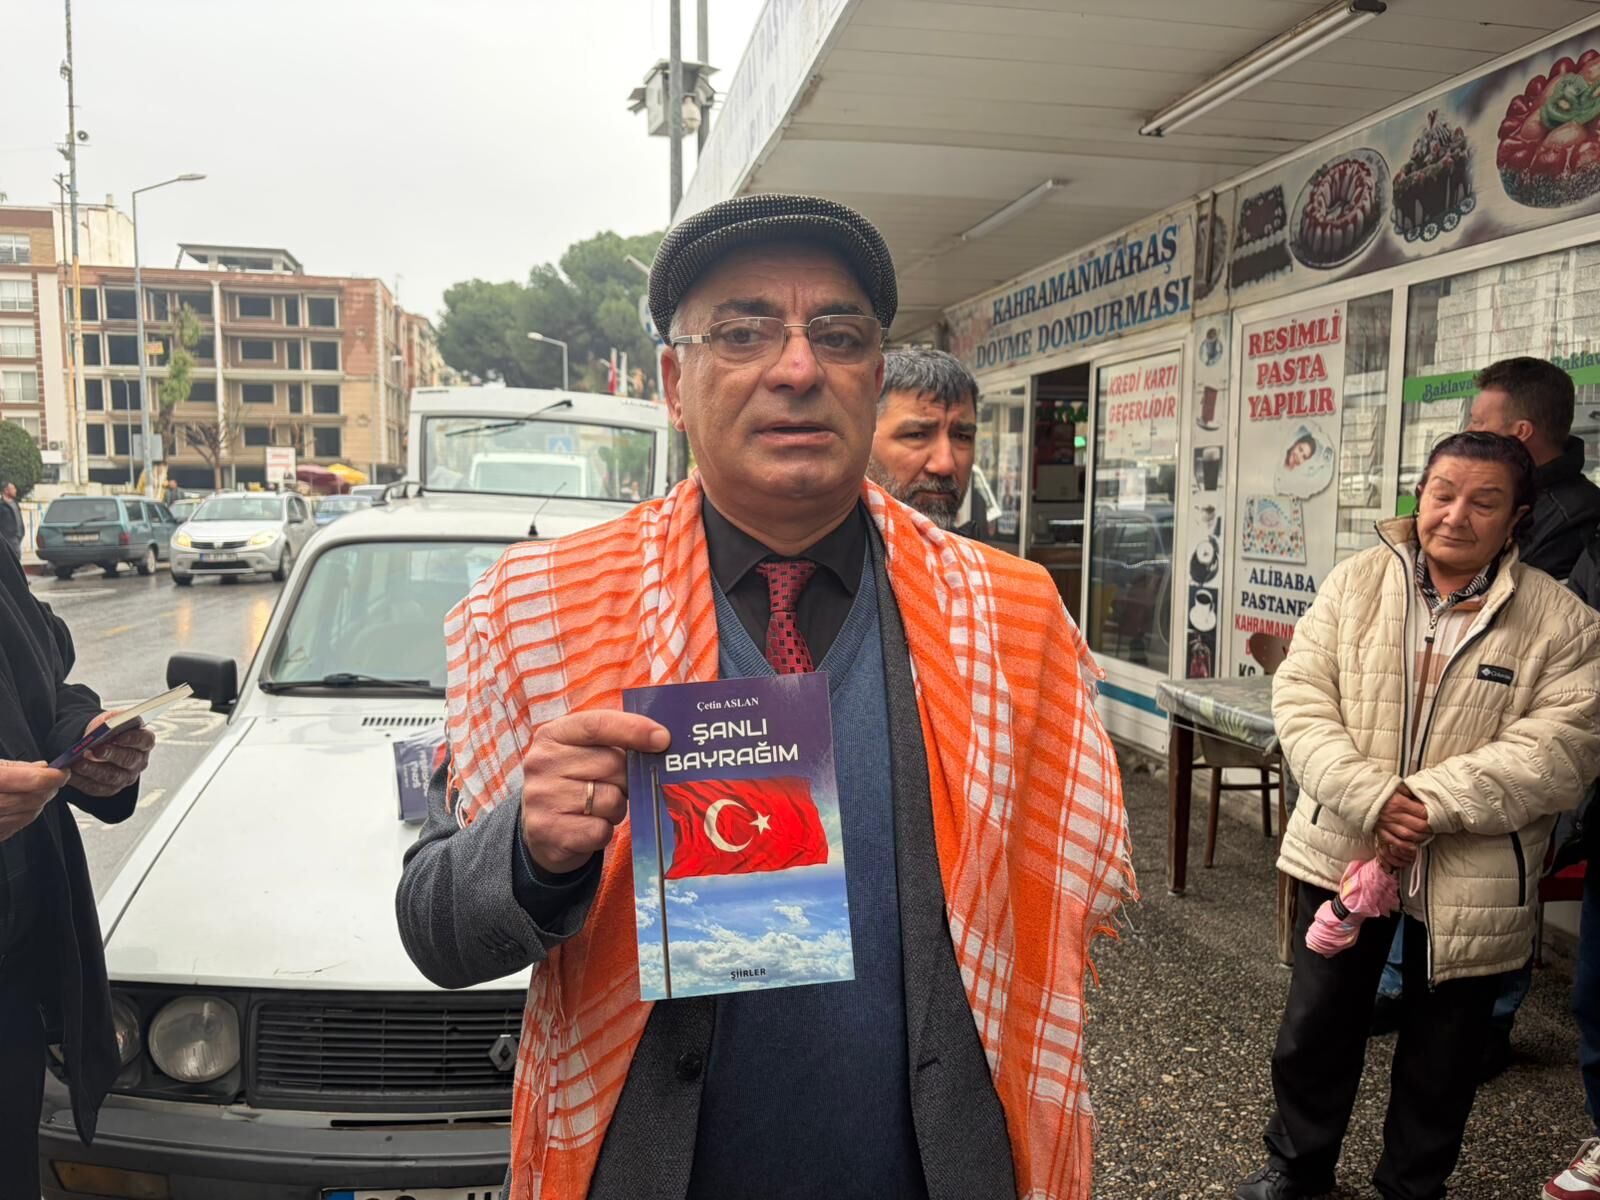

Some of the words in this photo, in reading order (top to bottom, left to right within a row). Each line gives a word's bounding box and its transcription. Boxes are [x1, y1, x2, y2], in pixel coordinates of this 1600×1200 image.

[992, 224, 1179, 327] KAHRAMANMARAŞ
[1037, 275, 1192, 352] DONDURMASI
[1248, 308, 1342, 358] RESİMLİ
[1143, 364, 1178, 391] KARTI
[1256, 353, 1327, 388] PASTA
[1248, 387, 1336, 419] YAPILIR
[1249, 565, 1316, 593] ALİBABA
[1235, 613, 1295, 639] KAHRAMANN
[696, 700, 722, 712] Çetin
[723, 697, 759, 709] ASLAN
[692, 718, 768, 745] ŞANLI
[665, 741, 799, 772] BAYRAĞIM
